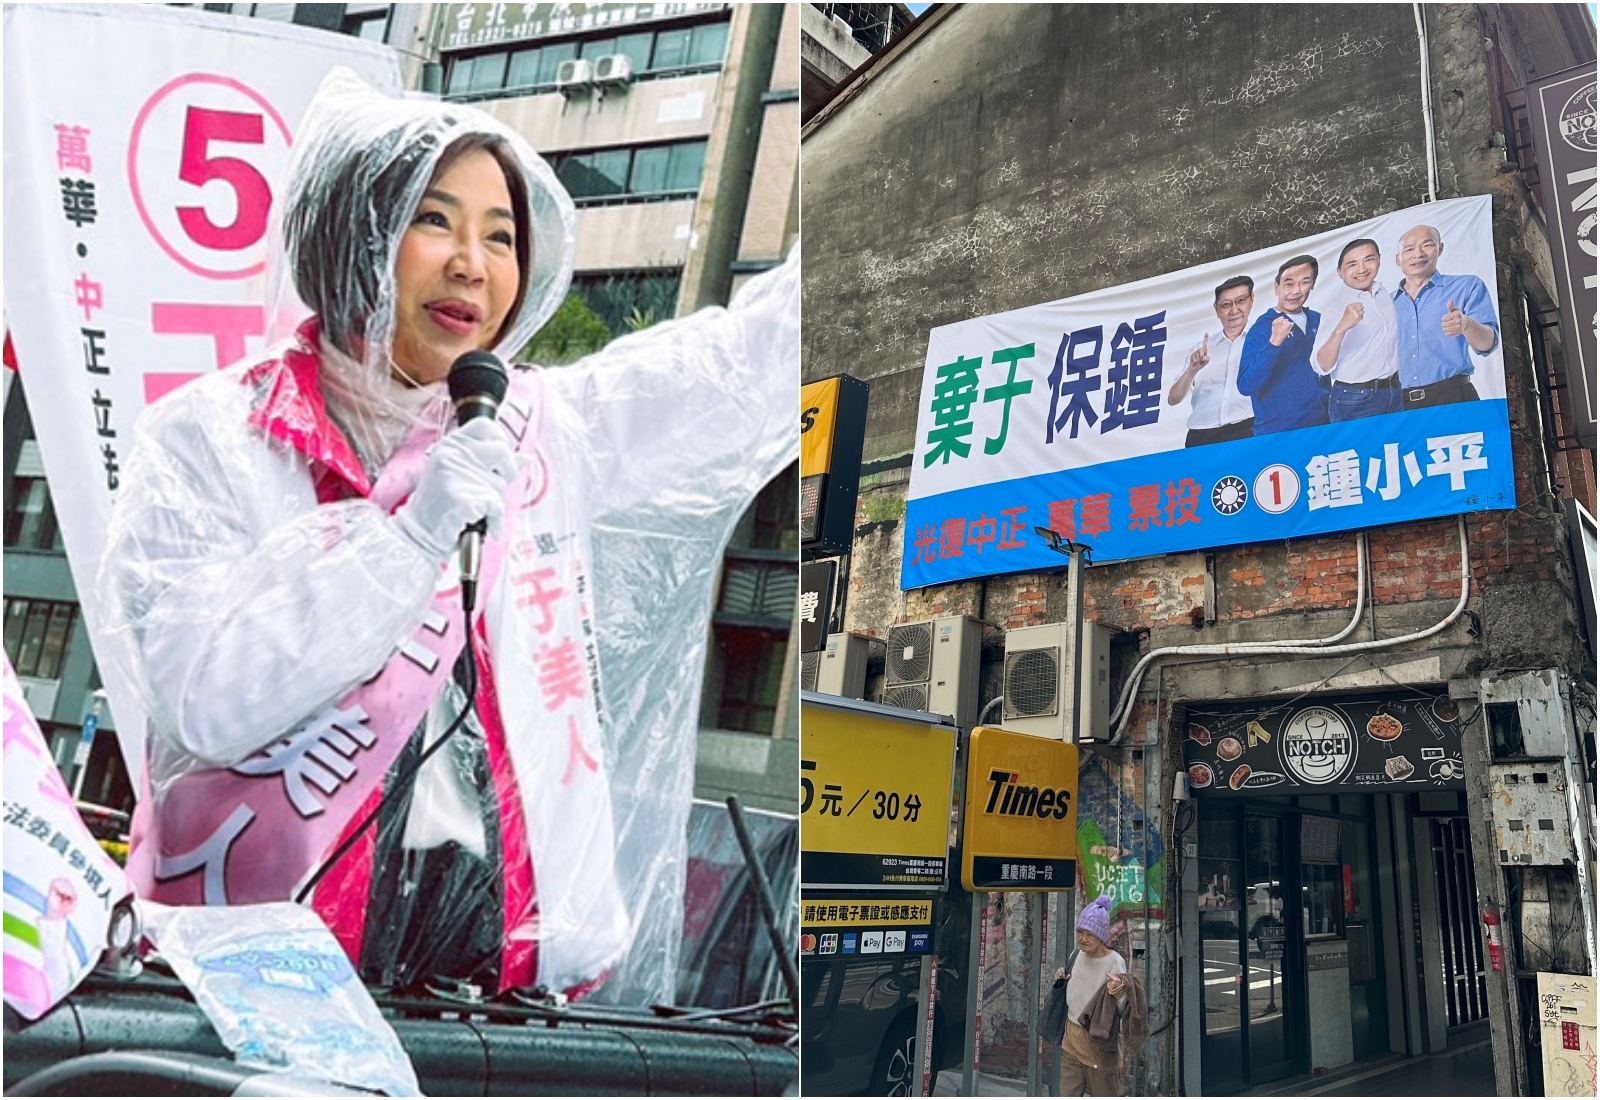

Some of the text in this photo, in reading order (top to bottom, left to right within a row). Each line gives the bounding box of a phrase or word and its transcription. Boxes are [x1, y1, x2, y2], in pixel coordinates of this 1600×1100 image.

[1566, 109, 1589, 119] SINCE
[175, 105, 273, 251] 5
[924, 310, 1167, 470] 棄于 保鍾
[911, 431, 1489, 567] 光復中正 萬華 票投 1 鍾小平
[513, 566, 598, 785] 于美人
[1295, 711, 1338, 726] COFFEE FACTORY
[1289, 739, 1346, 756] NOTCH
[985, 770, 1071, 820] Times
[3, 801, 113, 910] 法委員參選人
[882, 858, 897, 866] 62923
[1001, 864, 1053, 880] 重慶南路一段
[1095, 862, 1144, 885] UCIT
[1097, 882, 1143, 903] 2016
[804, 905, 928, 922] 請使用電子票證或感應支付
[869, 938, 881, 948] Pay
[886, 937, 904, 948] G Pay
[914, 939, 924, 947] pay
